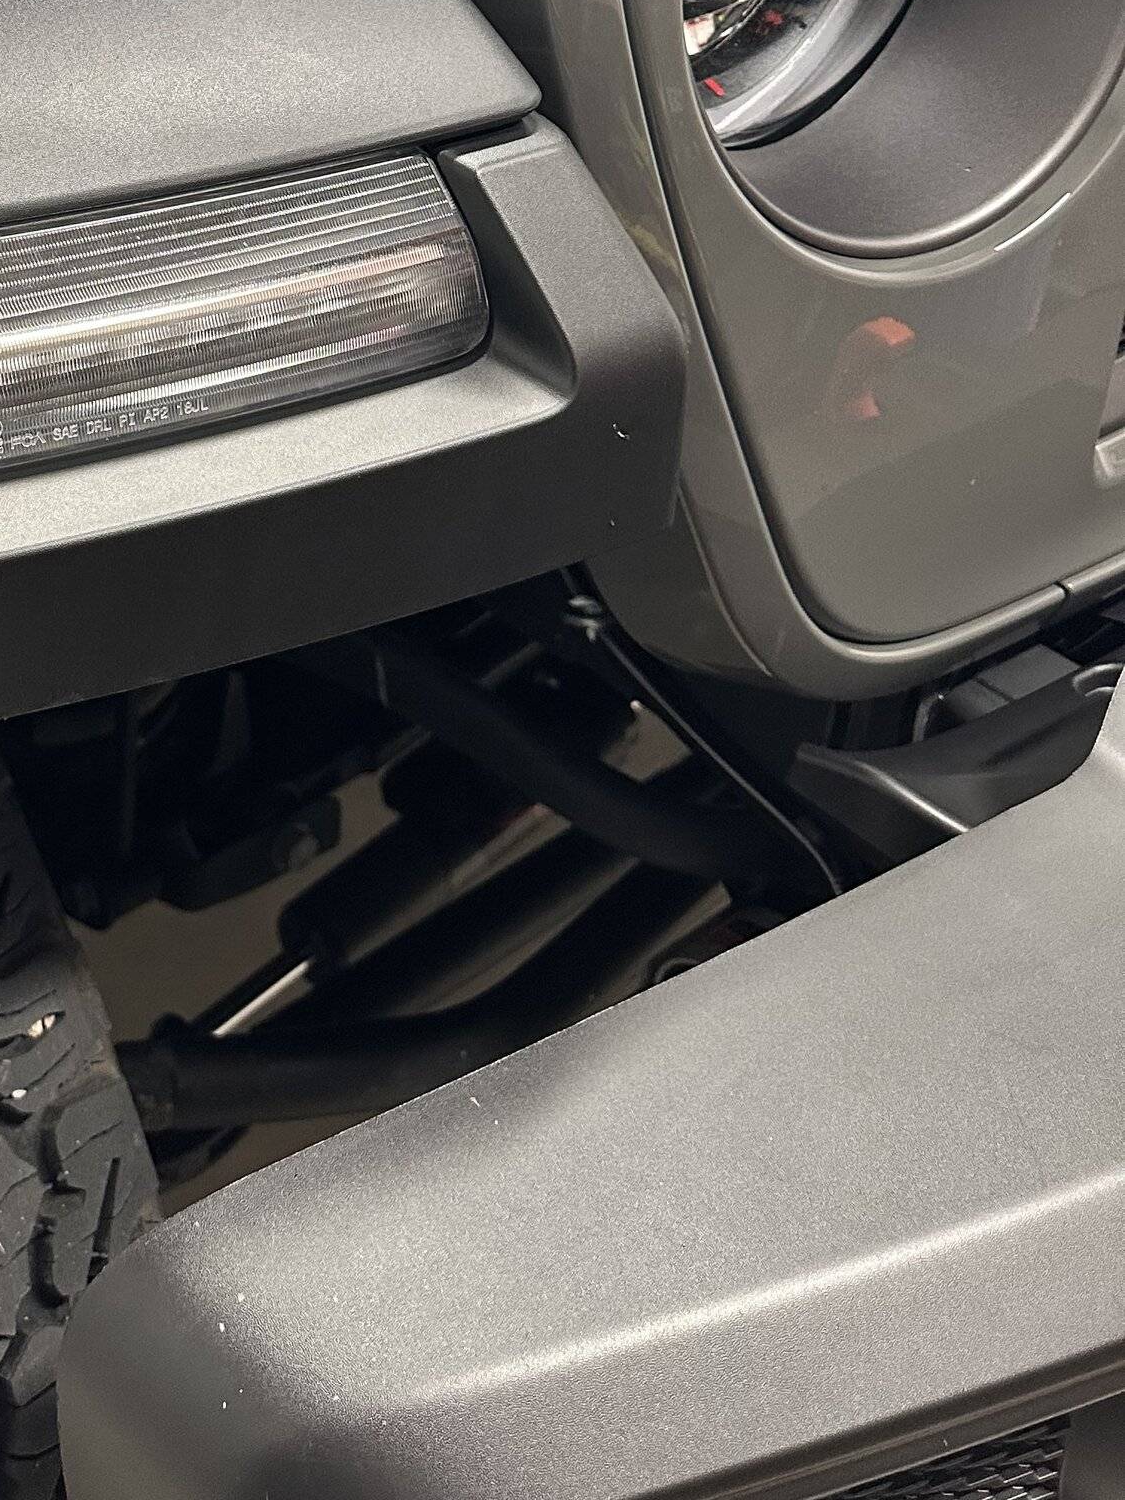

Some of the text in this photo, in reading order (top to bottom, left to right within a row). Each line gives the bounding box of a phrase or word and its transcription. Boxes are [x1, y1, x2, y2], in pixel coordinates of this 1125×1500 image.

[53, 424, 79, 442] SAE
[86, 417, 112, 436] DRL
[143, 406, 169, 424] AP2
[176, 399, 210, 417] 18JL
